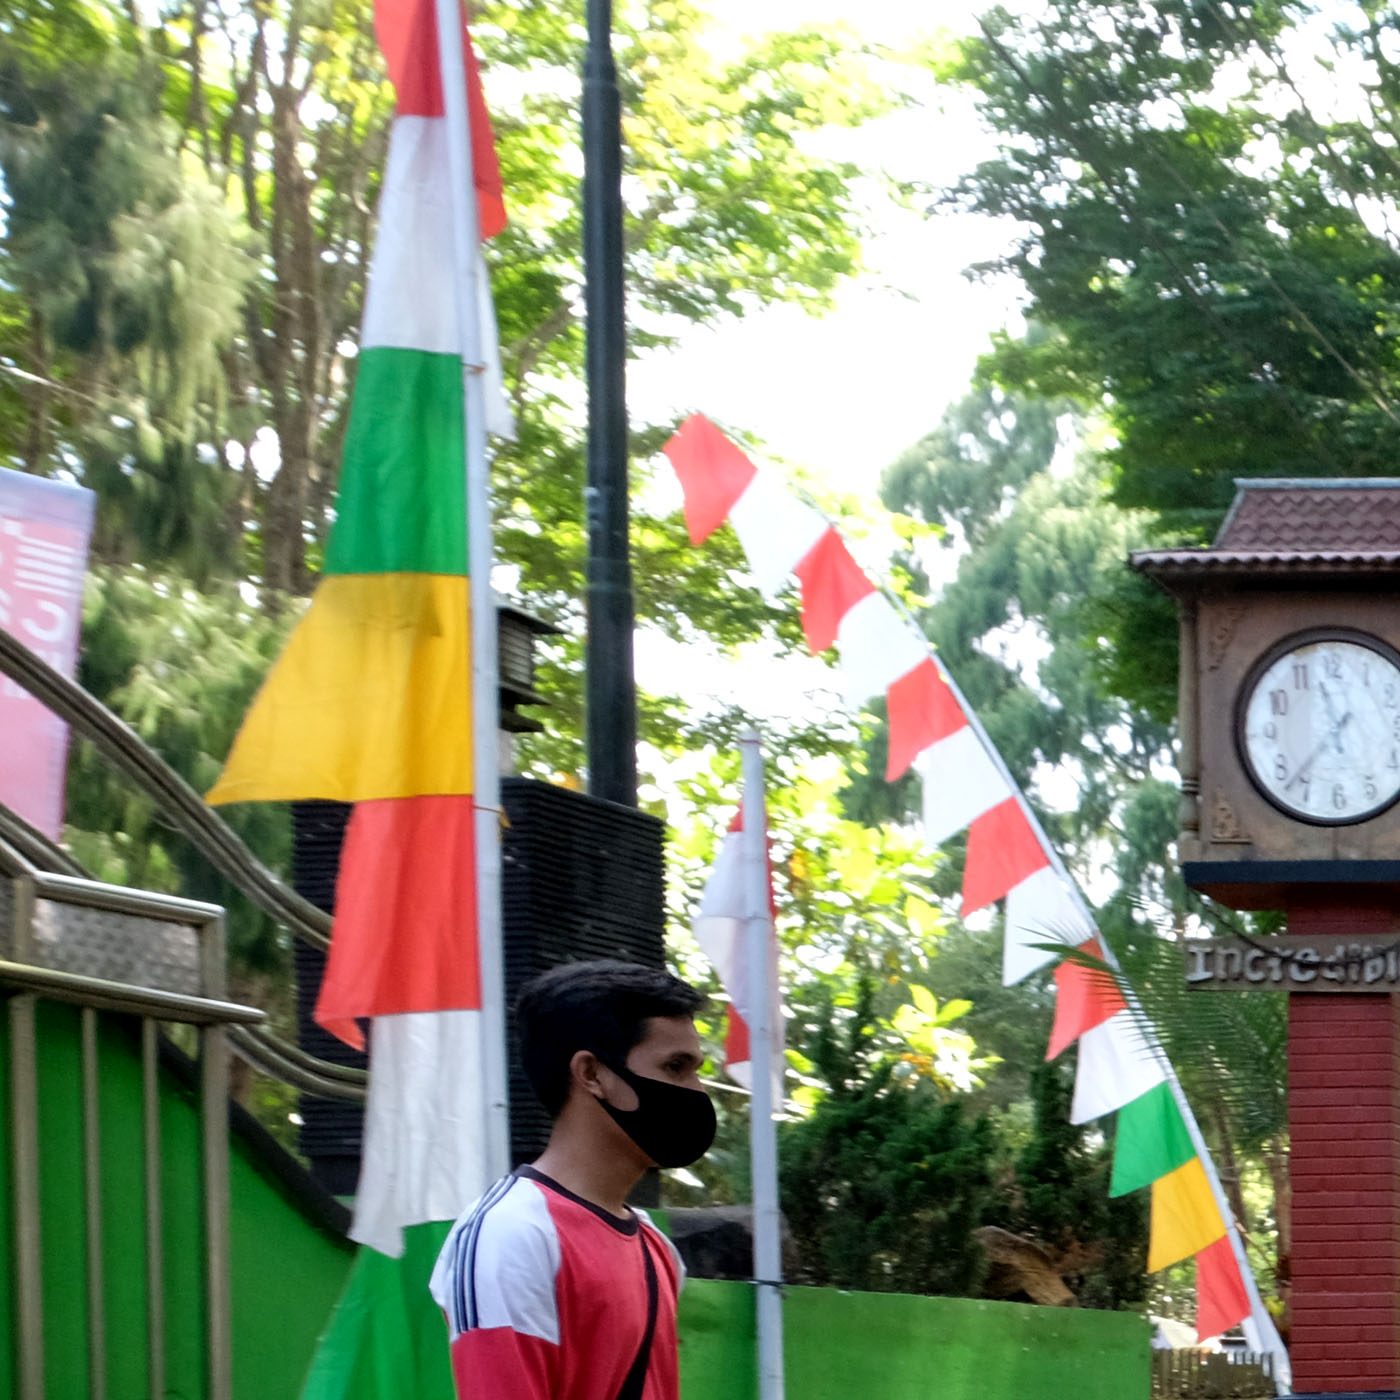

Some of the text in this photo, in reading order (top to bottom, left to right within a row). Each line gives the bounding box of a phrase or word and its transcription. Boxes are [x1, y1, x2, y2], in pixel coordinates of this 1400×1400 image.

[1293, 664, 1310, 690] 11
[1268, 689, 1289, 716] 10
[1332, 783, 1347, 810] 6
